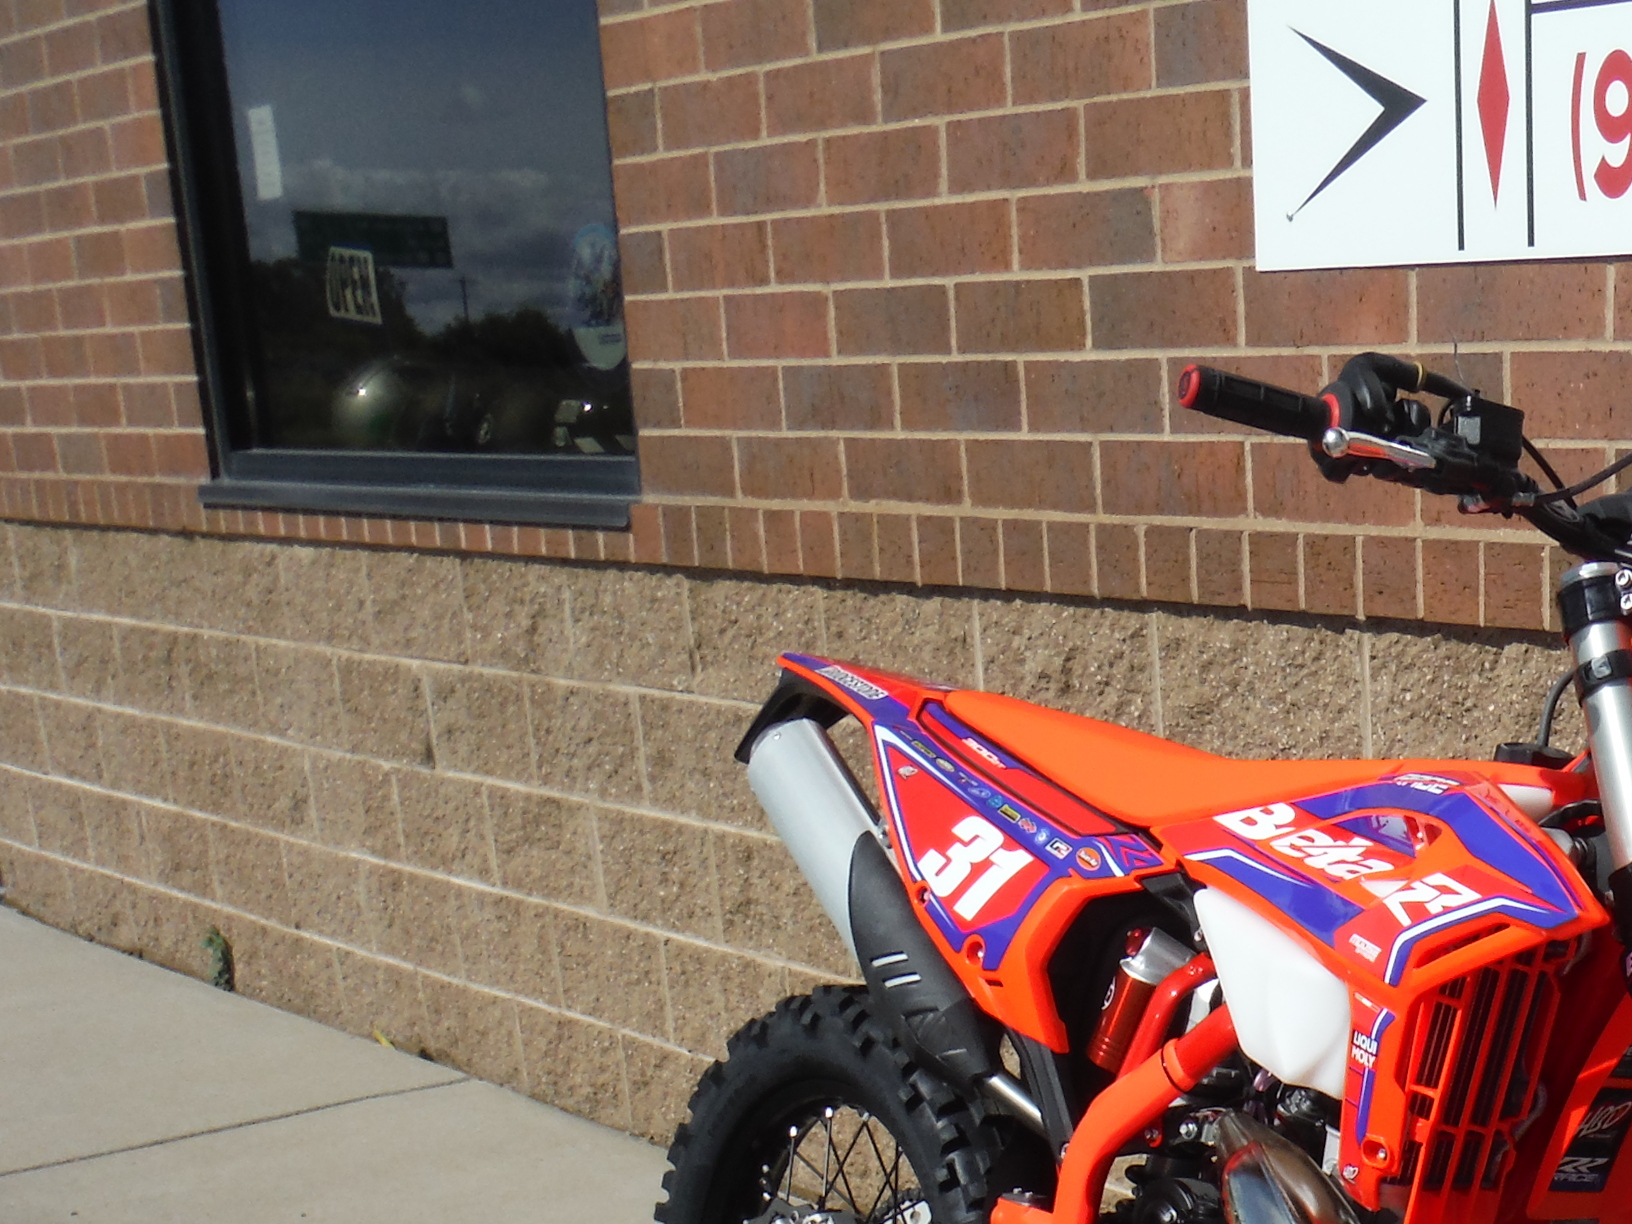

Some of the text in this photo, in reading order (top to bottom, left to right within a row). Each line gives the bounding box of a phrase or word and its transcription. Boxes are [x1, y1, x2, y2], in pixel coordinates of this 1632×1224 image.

[328, 252, 380, 320] OPEN
[917, 815, 1034, 922] 31
[1212, 801, 1396, 882] Beta
[1351, 1046, 1377, 1068] MOLY
[1353, 1030, 1378, 1055] LIQUI
